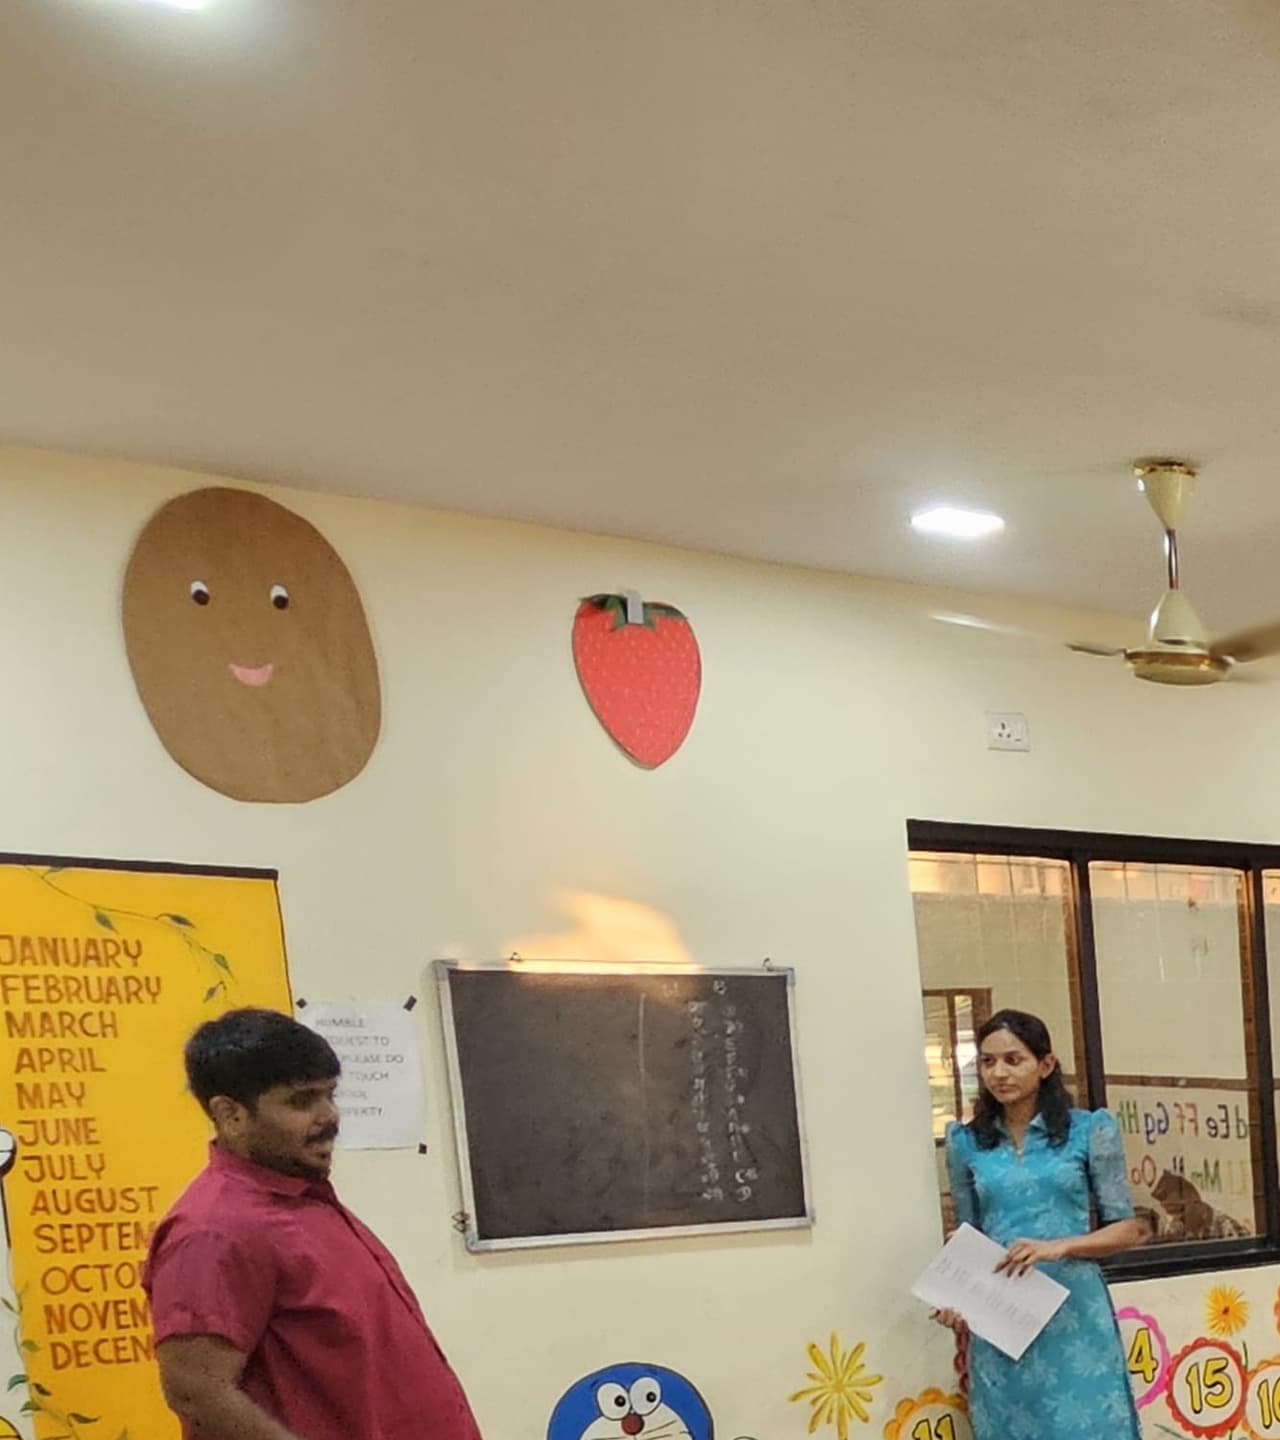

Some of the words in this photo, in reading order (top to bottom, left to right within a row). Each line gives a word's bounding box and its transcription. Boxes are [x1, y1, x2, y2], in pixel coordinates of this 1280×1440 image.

[0, 934, 143, 968] JANUARY
[0, 974, 161, 1004] FEBRUARY
[5, 1010, 118, 1038] MARCH
[15, 1047, 107, 1074] APRIL
[385, 1054, 404, 1064] DO
[16, 1082, 86, 1110] MAY
[17, 1117, 101, 1147] JUNE
[21, 1153, 106, 1183] JULY
[30, 1186, 159, 1216] AUGUST
[34, 1221, 156, 1253] SEPTEM
[42, 1261, 145, 1295] OCTO
[1128, 1328, 1158, 1383] 4
[1185, 1357, 1234, 1413] 15
